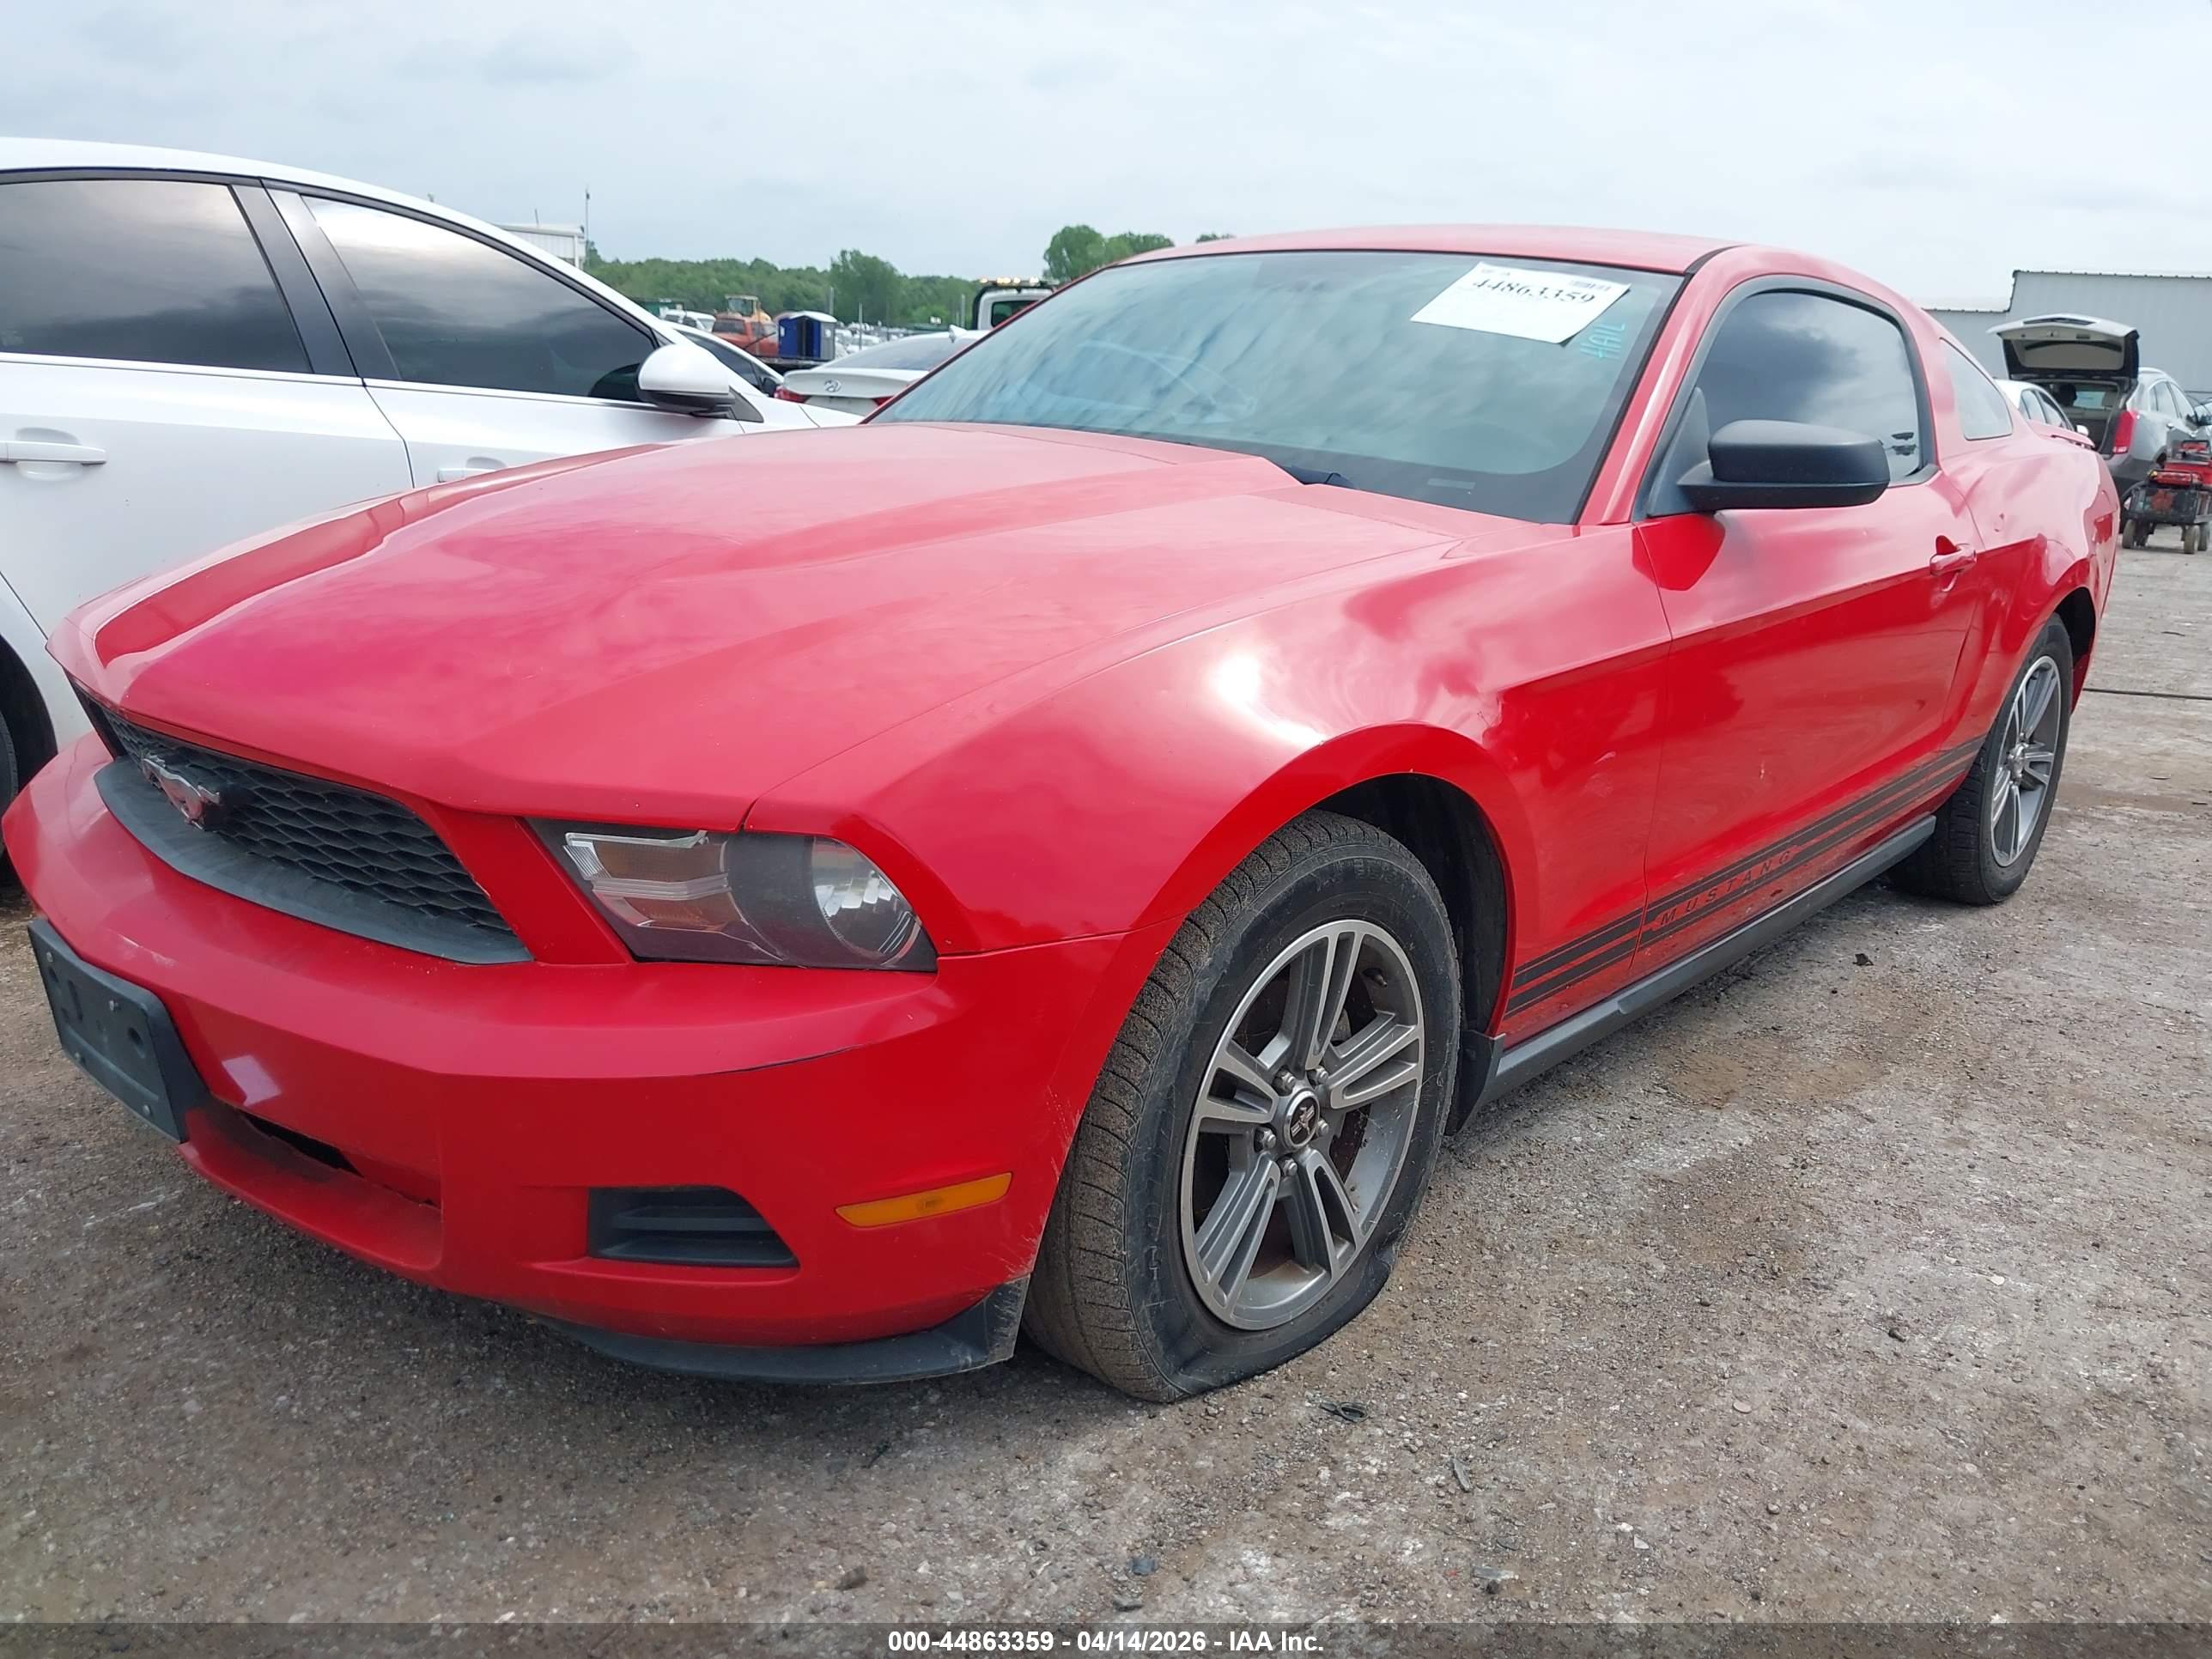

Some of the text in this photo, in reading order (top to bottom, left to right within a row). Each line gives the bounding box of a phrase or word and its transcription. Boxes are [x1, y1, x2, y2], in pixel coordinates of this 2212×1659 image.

[1473, 278, 1596, 304] 44863359
[1579, 322, 1626, 360] HAIL
[1661, 851, 1790, 926] MUSTANG
